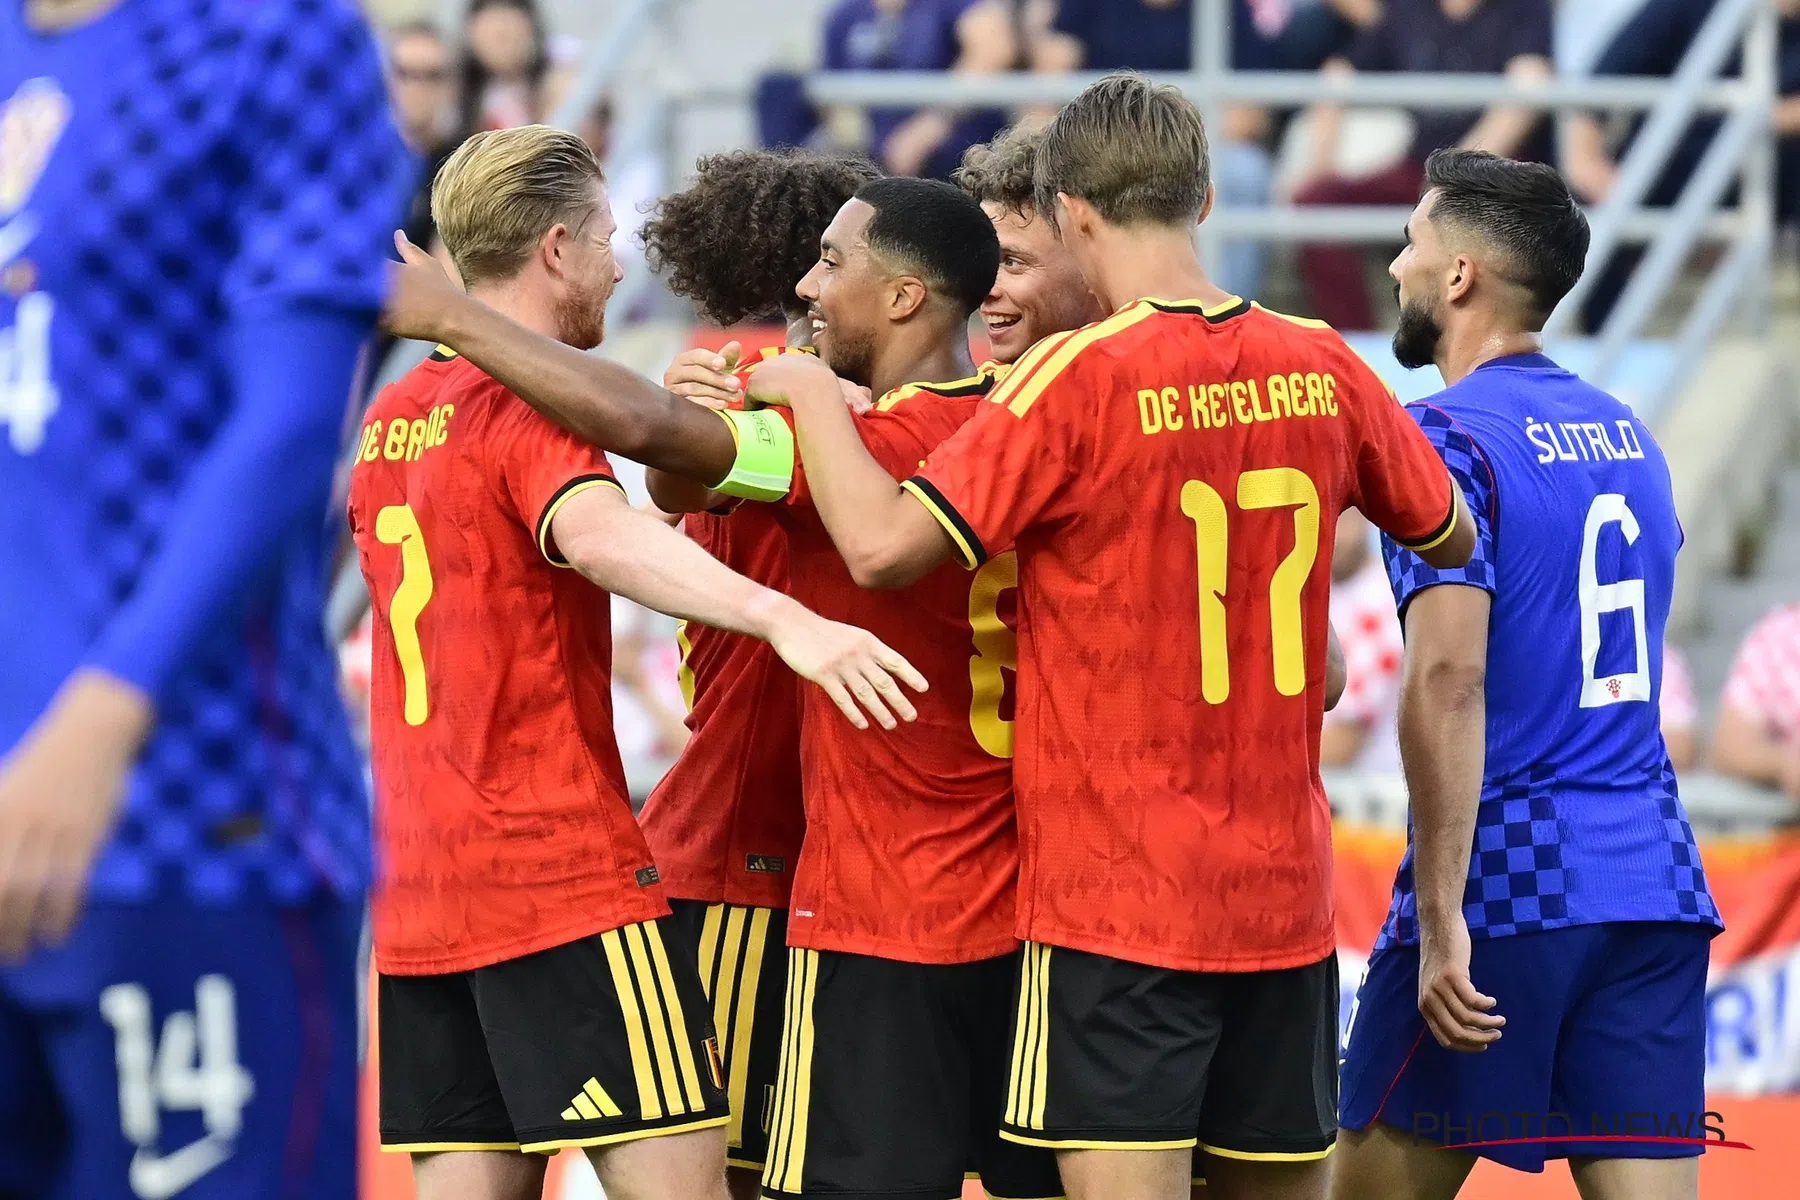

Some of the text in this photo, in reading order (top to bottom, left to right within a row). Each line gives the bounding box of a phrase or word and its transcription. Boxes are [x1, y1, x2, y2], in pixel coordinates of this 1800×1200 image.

[353, 419, 382, 467] DE
[1137, 386, 1184, 435] DE
[375, 503, 433, 726] 7
[1180, 467, 1320, 705] 17
[1578, 493, 1651, 708] 6
[99, 974, 255, 1146] 14
